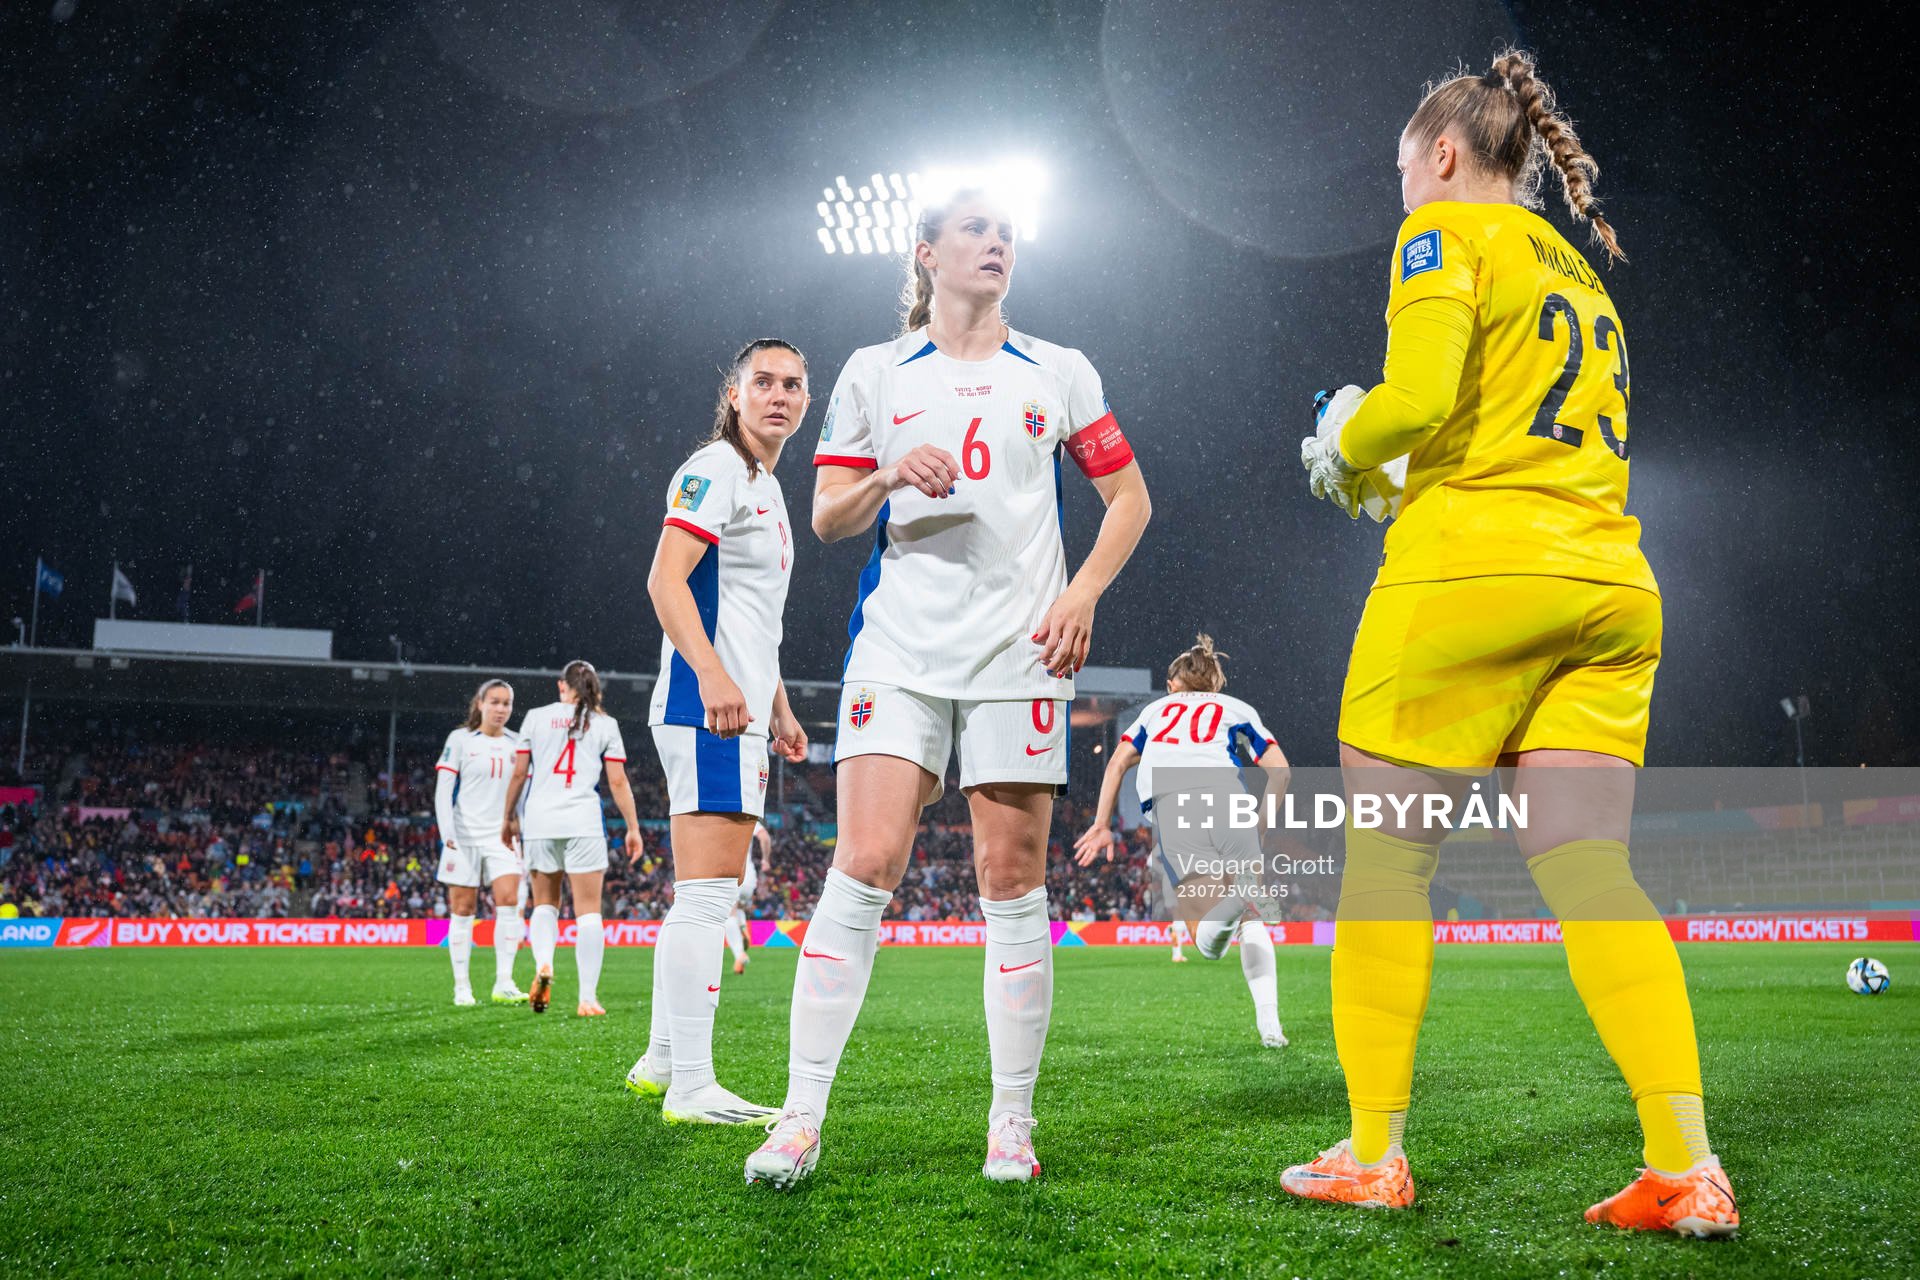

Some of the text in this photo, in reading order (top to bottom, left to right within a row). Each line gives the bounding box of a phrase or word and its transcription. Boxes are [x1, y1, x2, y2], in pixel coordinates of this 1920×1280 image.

[1527, 234, 1604, 295] MIKALSE
[1527, 293, 1630, 461] 23
[962, 417, 991, 480] 6
[1152, 702, 1223, 745] 20
[491, 757, 502, 778] 11
[553, 738, 576, 788] 4
[0, 925, 51, 941] AND
[117, 923, 408, 943] BUY YOUR TICKET NOW!
[878, 925, 986, 943] OUR TICKET
[1451, 925, 1489, 942] YOUR
[1491, 923, 1539, 942] TICKET
[1542, 923, 1562, 942] NO
[1687, 917, 1868, 941] FIFA.COM/TICKETS
